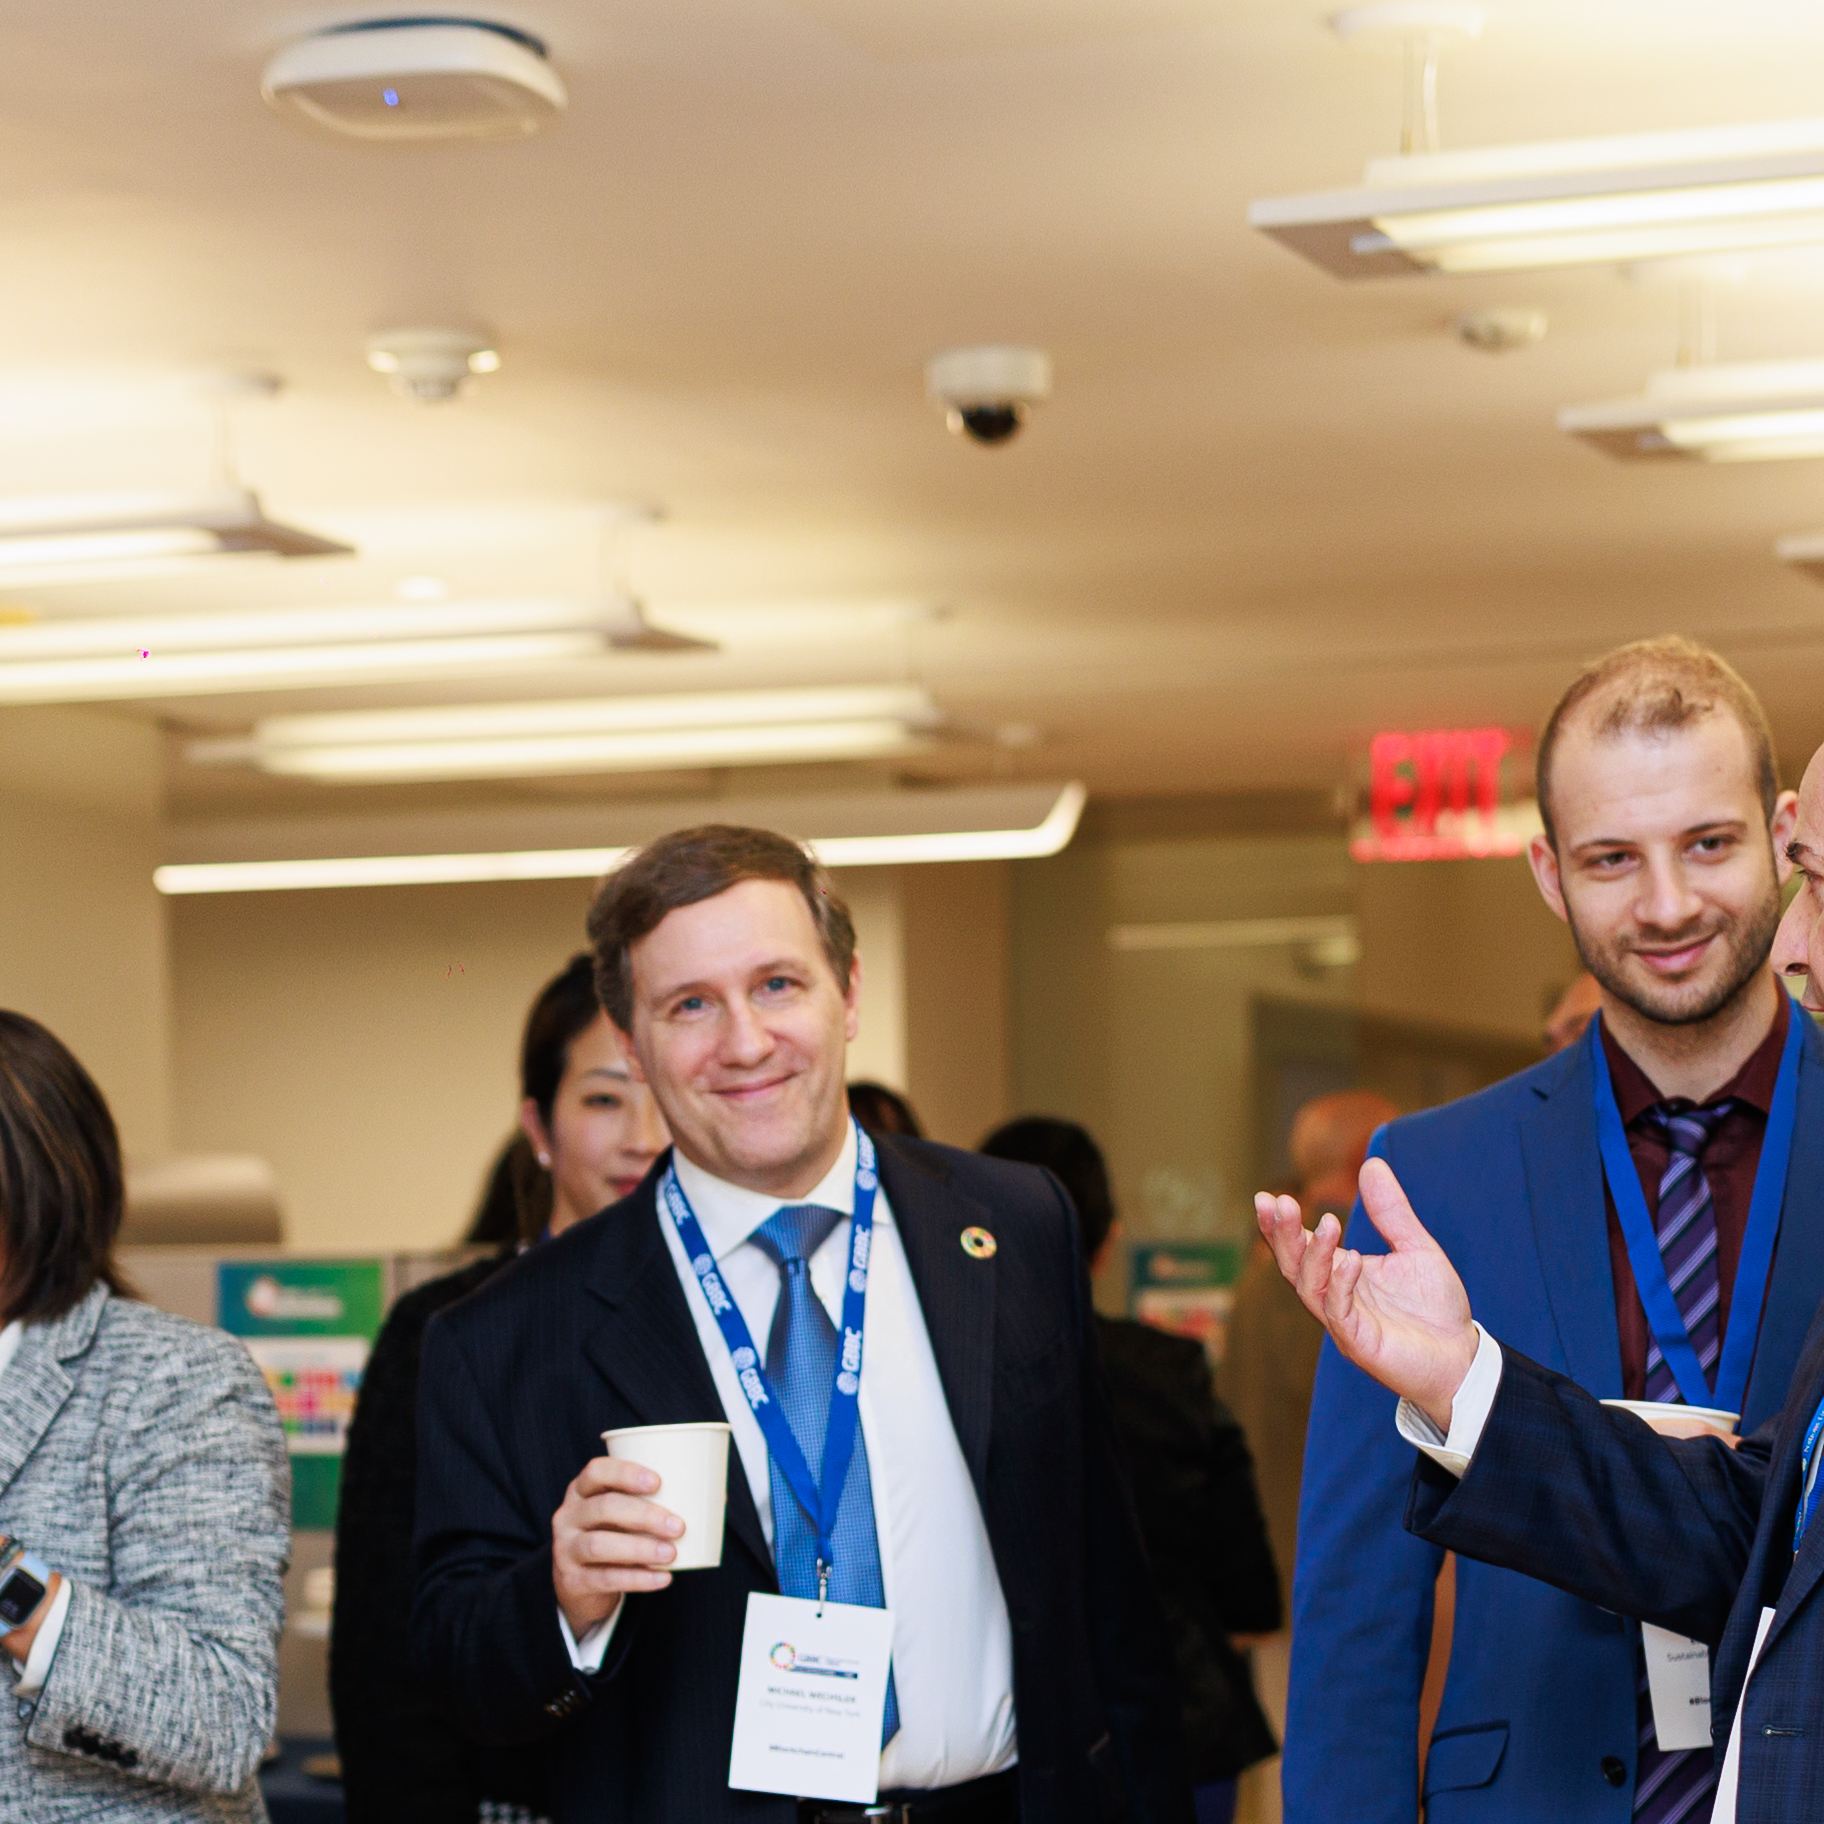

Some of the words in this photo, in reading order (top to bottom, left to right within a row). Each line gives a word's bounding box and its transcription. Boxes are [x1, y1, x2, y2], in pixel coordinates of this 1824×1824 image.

[853, 1223, 871, 1270] GBBC
[701, 1272, 732, 1316] GBBC
[841, 1326, 862, 1373] GBBC
[740, 1367, 769, 1410] GBBC
